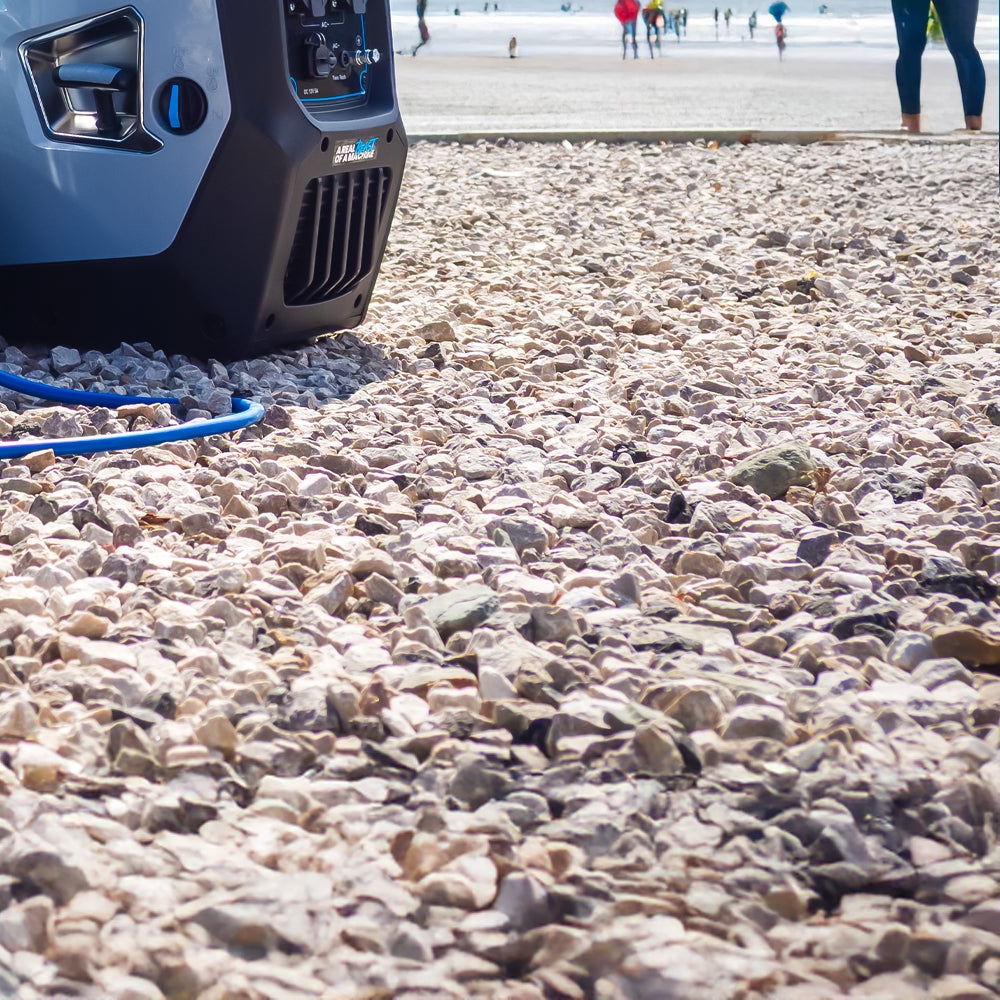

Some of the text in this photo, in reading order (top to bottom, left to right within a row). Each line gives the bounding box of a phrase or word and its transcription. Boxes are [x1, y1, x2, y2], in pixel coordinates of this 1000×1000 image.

[335, 137, 379, 155] A REAL BEAST
[334, 149, 375, 163] OF A MACHINE
